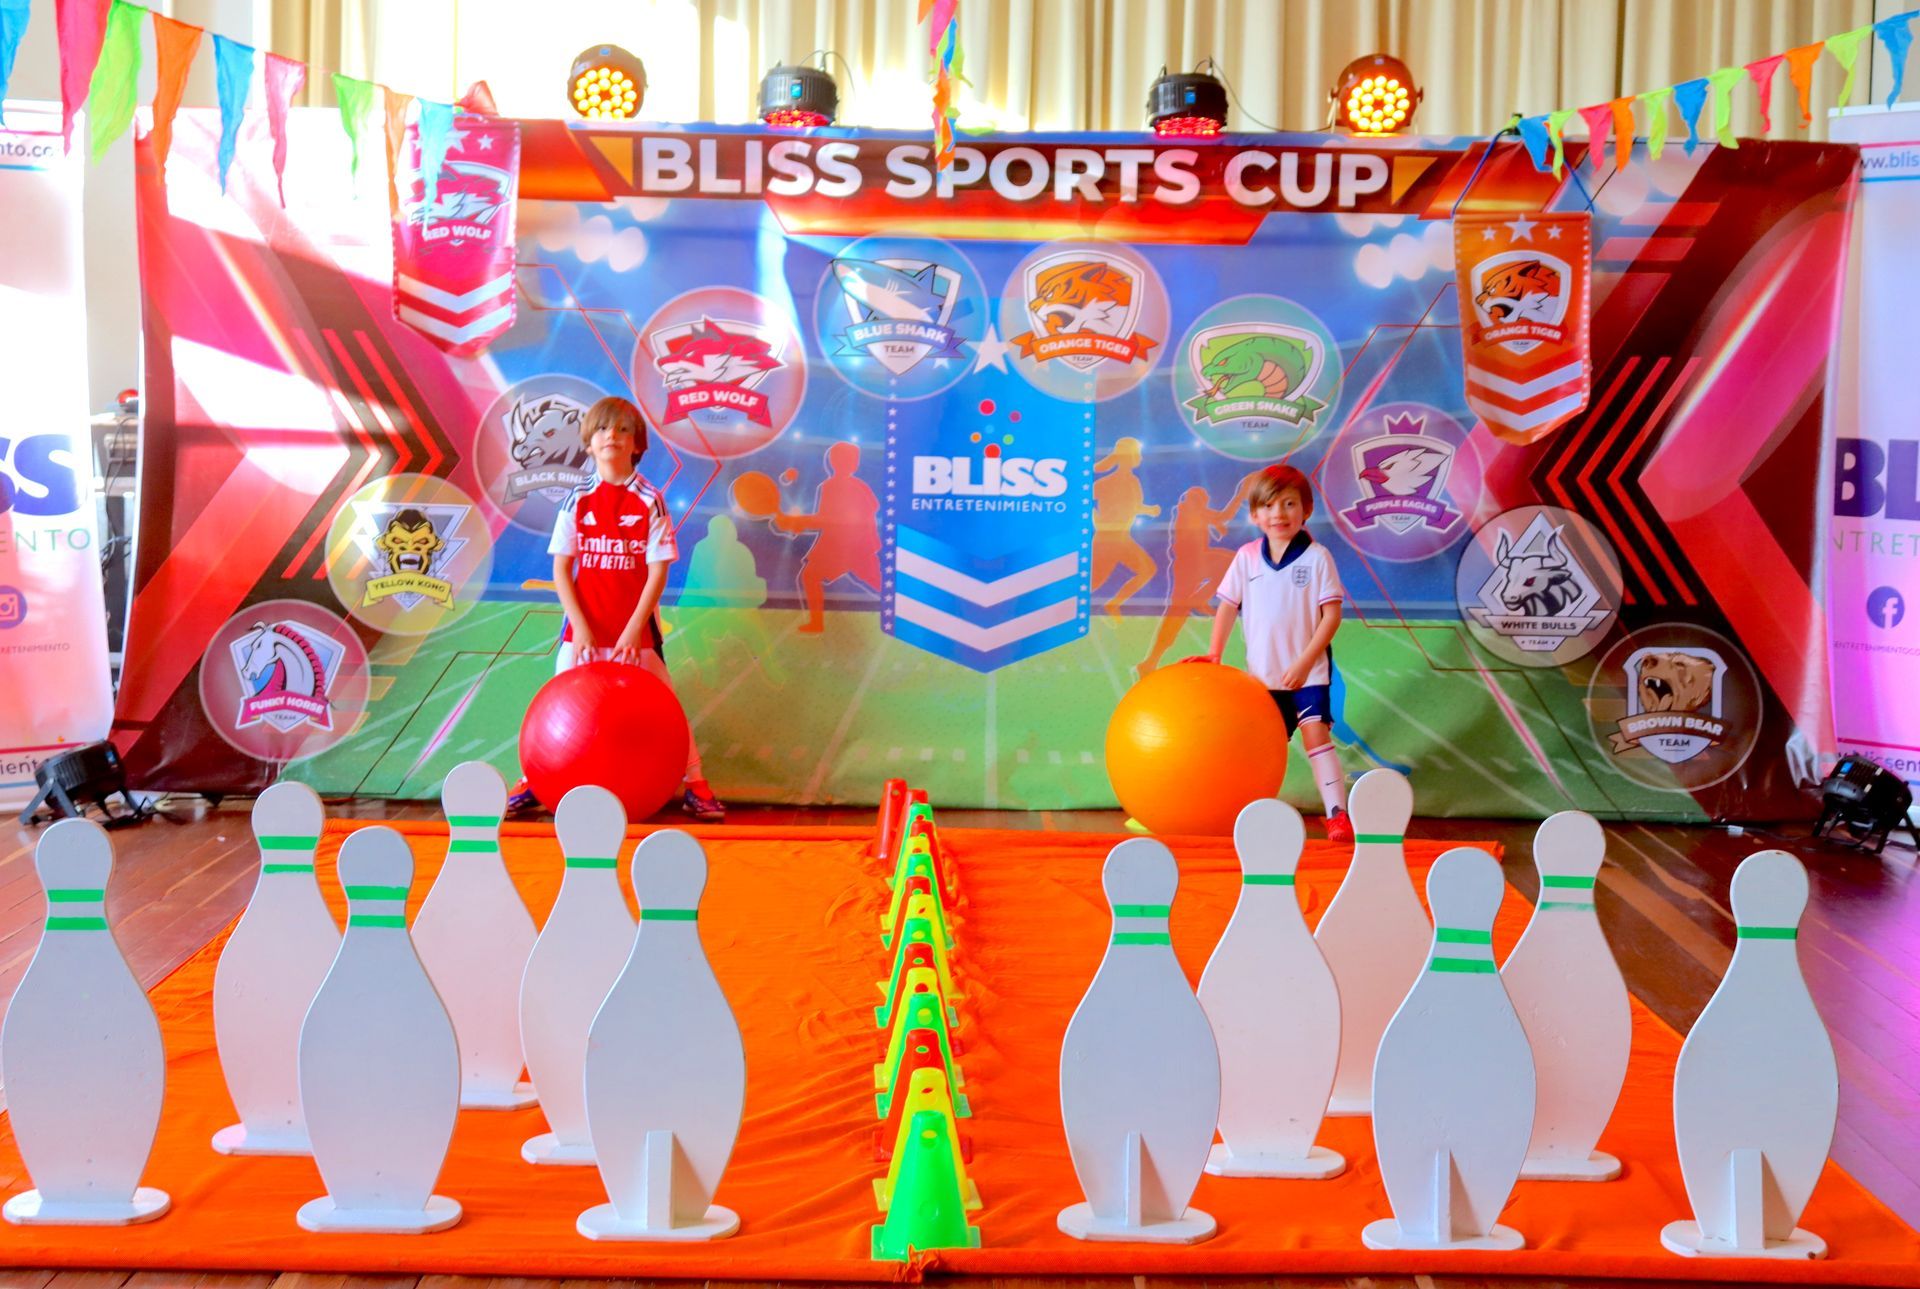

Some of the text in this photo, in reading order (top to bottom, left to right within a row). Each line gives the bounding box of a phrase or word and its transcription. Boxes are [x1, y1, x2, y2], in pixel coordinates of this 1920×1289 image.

[642, 137, 1389, 208] BLISS SPORTS CUP
[452, 225, 491, 239] WOLF
[853, 323, 947, 343] BLUE SHARK
[1484, 325, 1561, 340] ORANGE TIGER
[884, 345, 915, 353] TEAM
[1039, 338, 1130, 356] ORANGE TIGER
[678, 390, 759, 407] RED WOLF
[1214, 401, 1299, 417] GREEN SNAKE
[1241, 421, 1269, 429] TEAM
[912, 443, 1068, 498] BLISS
[515, 471, 556, 486] BLACK
[911, 498, 1067, 513] ENTRETENIMIENTO
[1365, 500, 1437, 513] PURPLE EAGLES
[577, 532, 646, 554] Emirates
[582, 553, 635, 570] FLY BETTER
[374, 580, 445, 592] YELLOW KONG
[1501, 621, 1577, 630] WHITE BULLS
[250, 696, 324, 714] FUNKY HORSE
[1628, 716, 1723, 735] BROWN BEAR
[1658, 738, 1691, 746] TEAM
